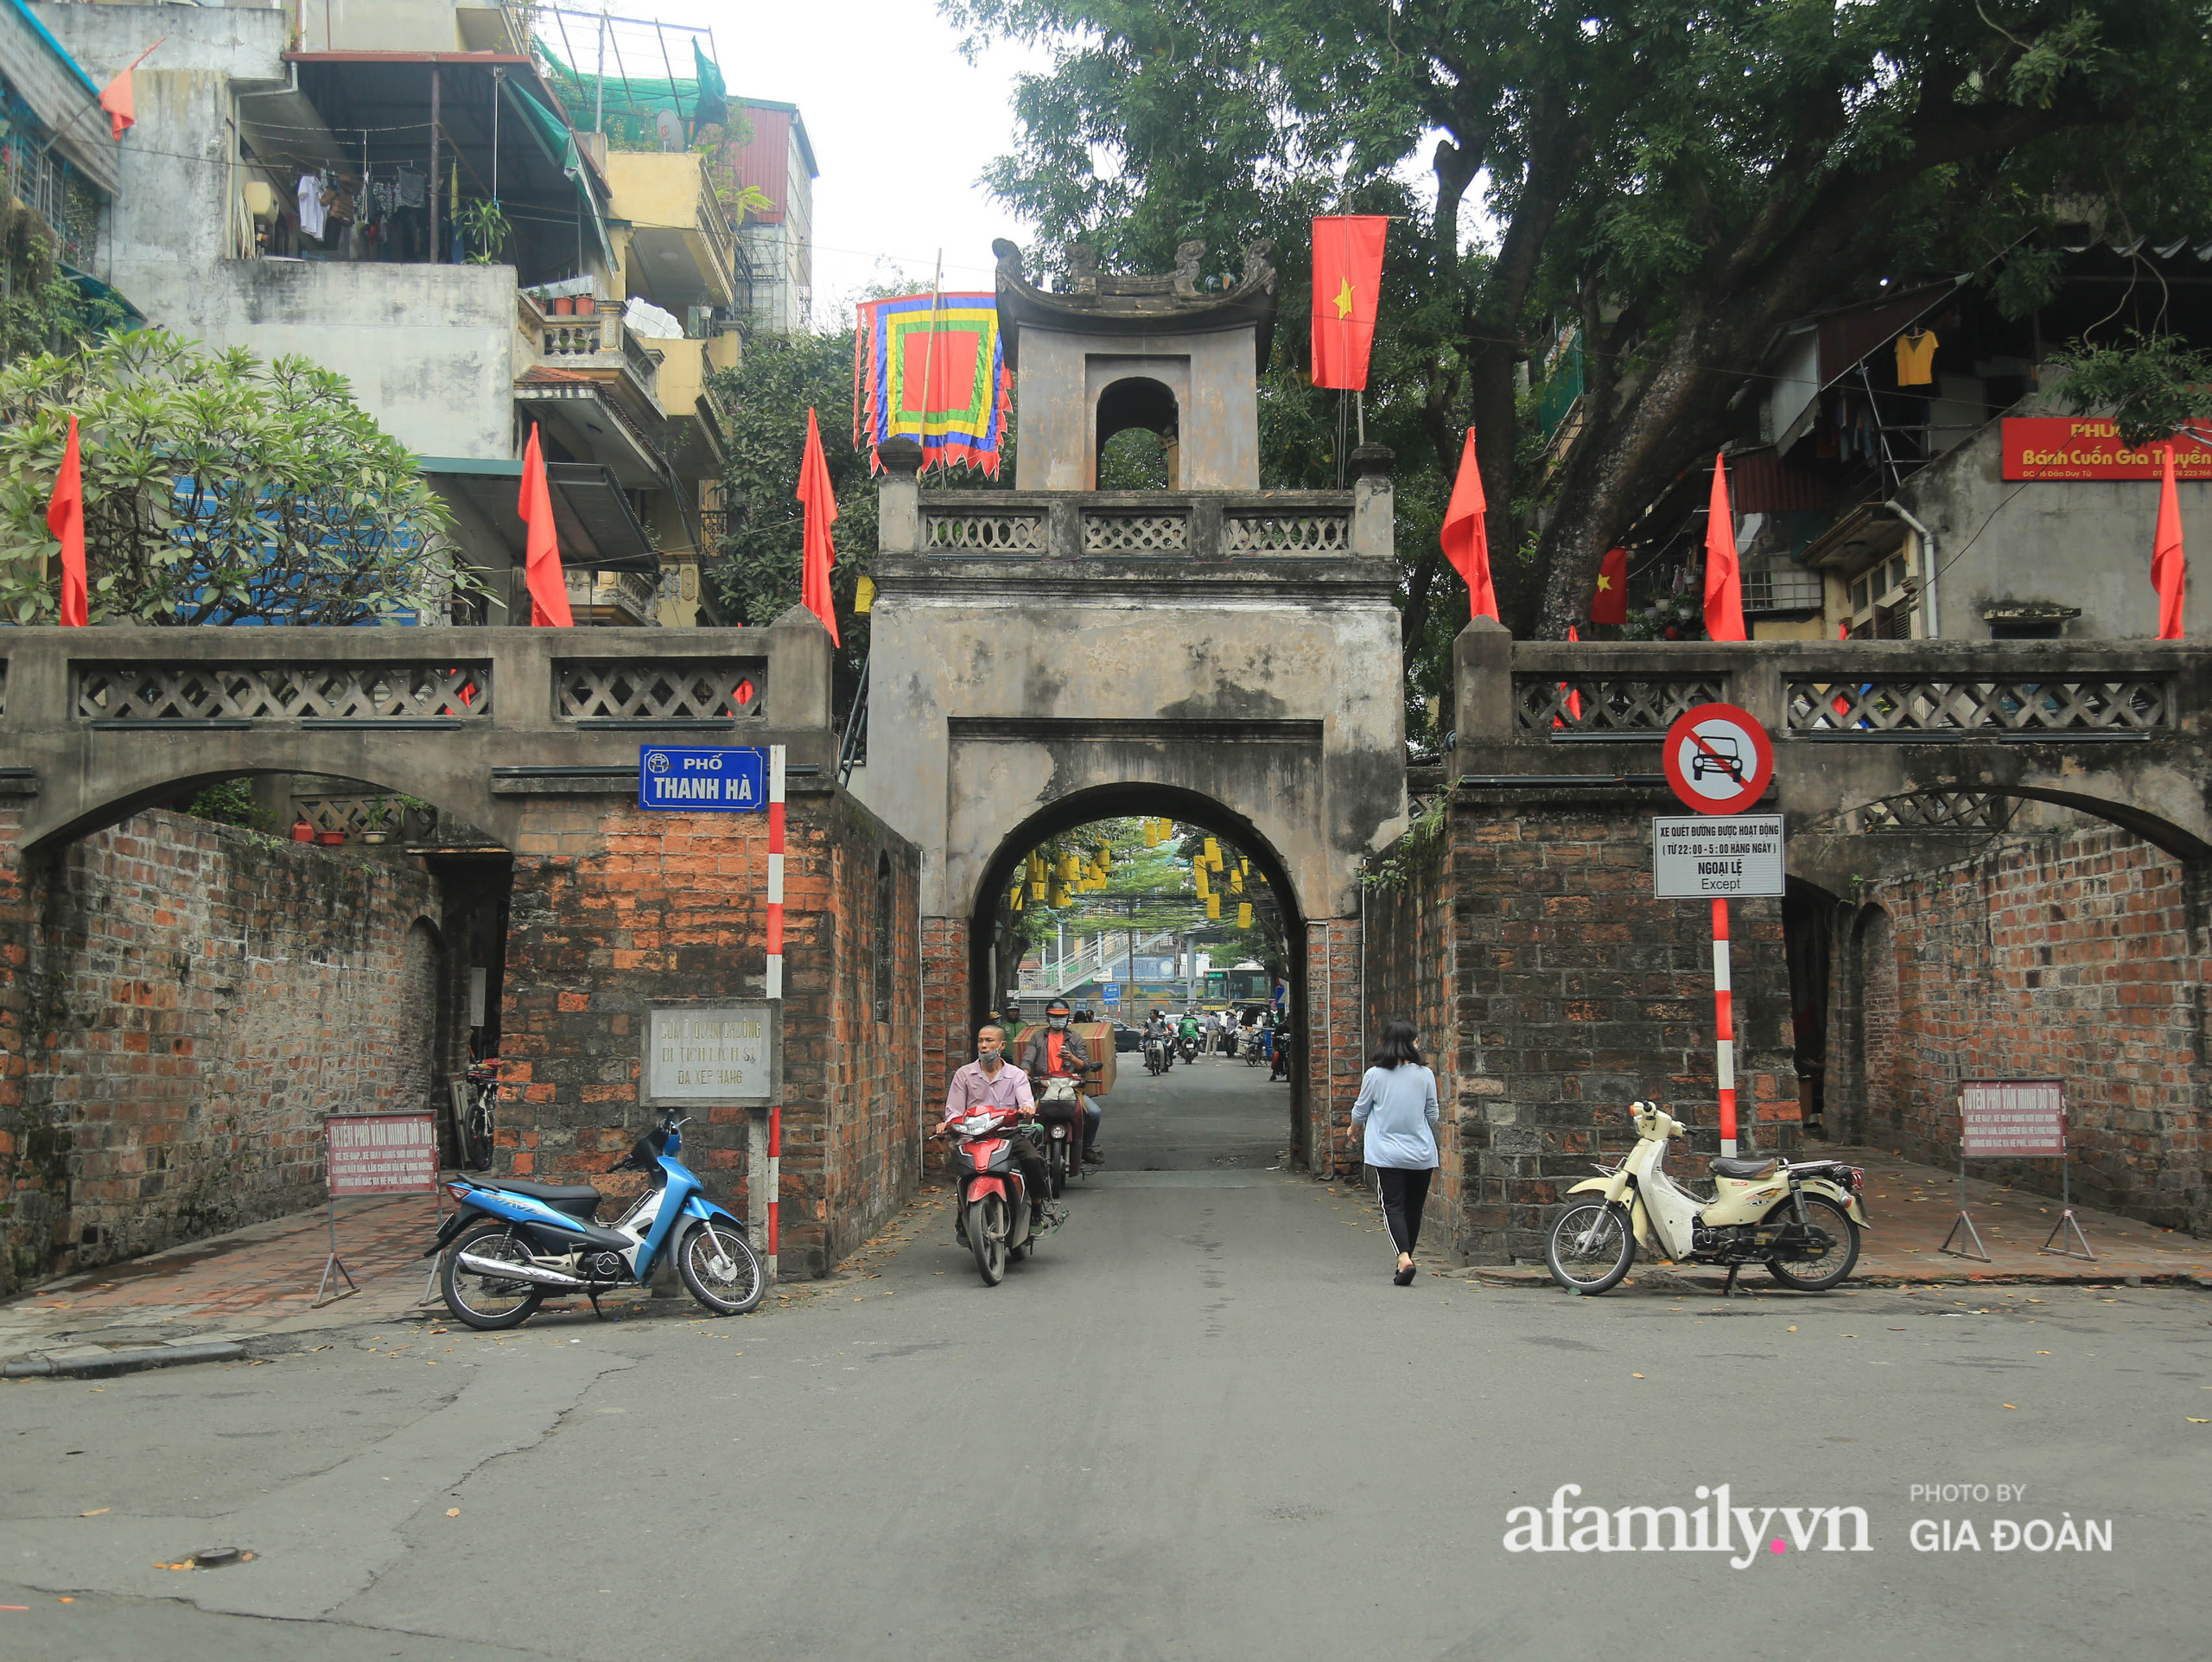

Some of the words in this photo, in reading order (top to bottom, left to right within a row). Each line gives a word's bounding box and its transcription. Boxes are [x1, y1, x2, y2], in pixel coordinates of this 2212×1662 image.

[2023, 449, 2068, 465] Bánh
[2070, 445, 2113, 465] Cuốn
[2115, 449, 2149, 465] Gia
[683, 754, 723, 770] PHỐ
[654, 777, 719, 799] THANH
[725, 774, 753, 800] HÀ
[1660, 827, 1669, 837] XE
[1671, 825, 1689, 837] QUÉT
[1691, 824, 1716, 837] ĐƯỜNG
[1718, 825, 1737, 838] ĐƯỢC
[1738, 825, 1758, 837] HOẠT
[1759, 822, 1779, 837] ĐỘNG
[1730, 841, 1750, 854] HÀNG
[1698, 861, 1728, 876] NGOẠI
[1731, 859, 1743, 876] LỆ
[1701, 878, 1740, 892] Except
[694, 1021, 720, 1040] QUAN
[662, 1048, 673, 1062] DI
[330, 1118, 353, 1148] TUYẾN
[354, 1118, 370, 1147] PHỐ
[371, 1119, 386, 1146] VĂN
[387, 1123, 408, 1145] MINH
[408, 1118, 419, 1145] ĐÔ
[362, 1150, 370, 1160] XE
